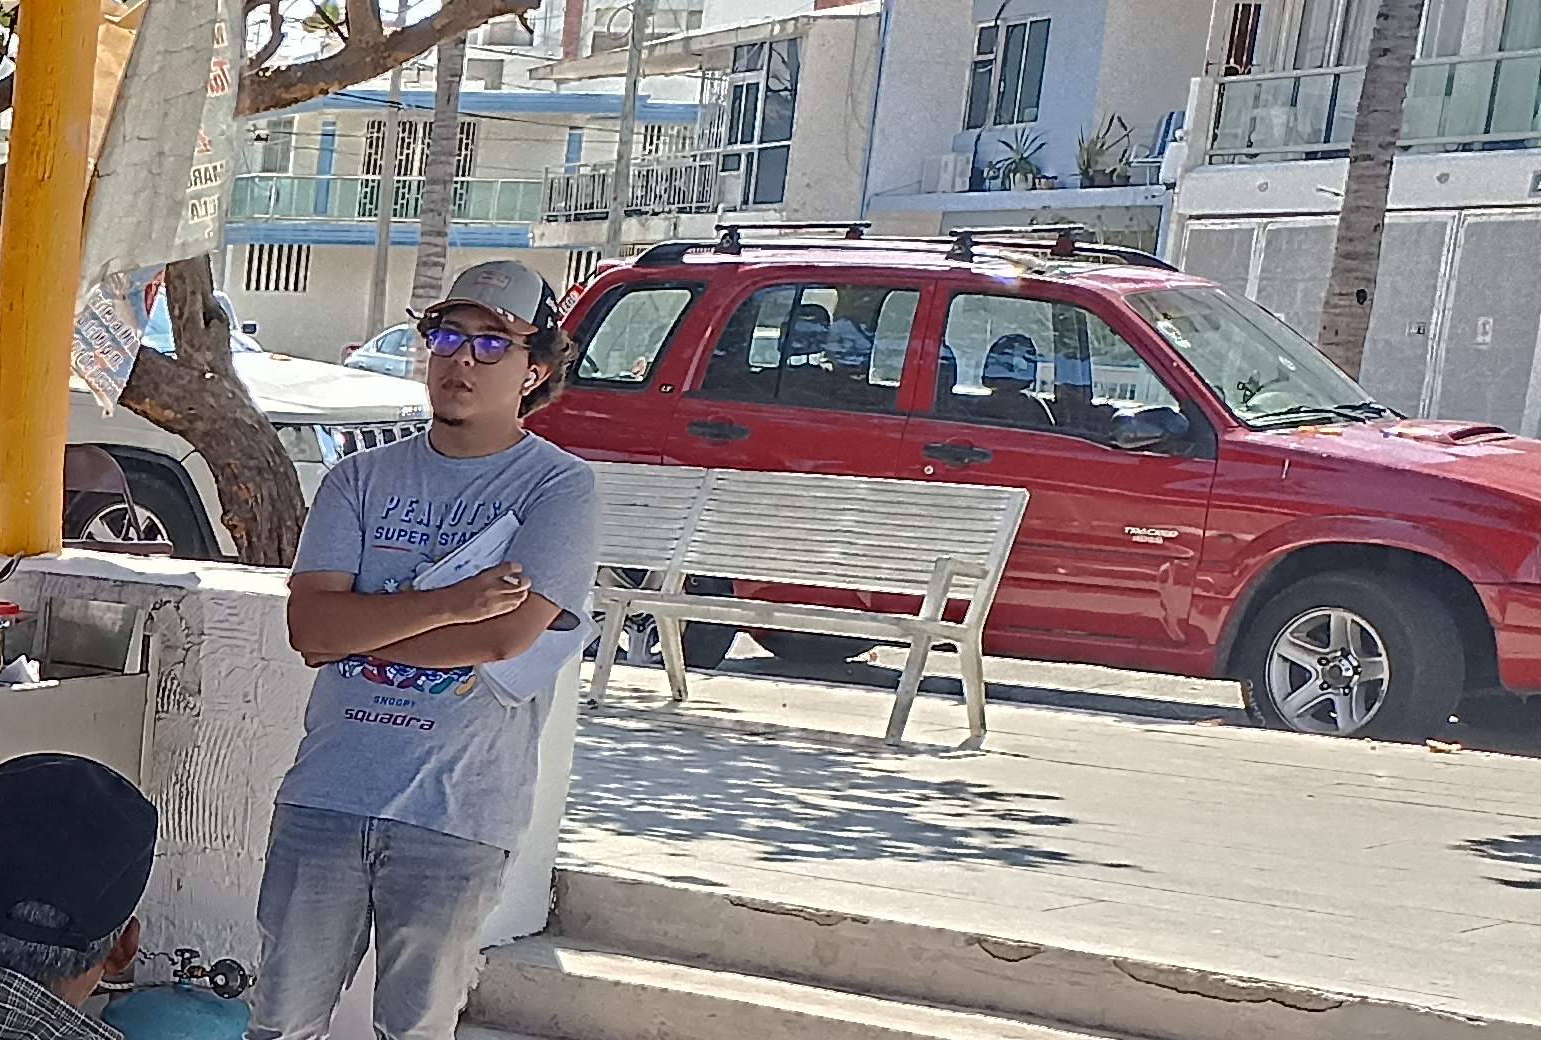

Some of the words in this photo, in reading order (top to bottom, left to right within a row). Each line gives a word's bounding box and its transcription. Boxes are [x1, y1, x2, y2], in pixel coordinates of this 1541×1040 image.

[381, 496, 503, 529] PEANUTS
[374, 526, 430, 546] SUPER
[373, 695, 417, 708] SNOOPY
[344, 708, 436, 731] squadra
